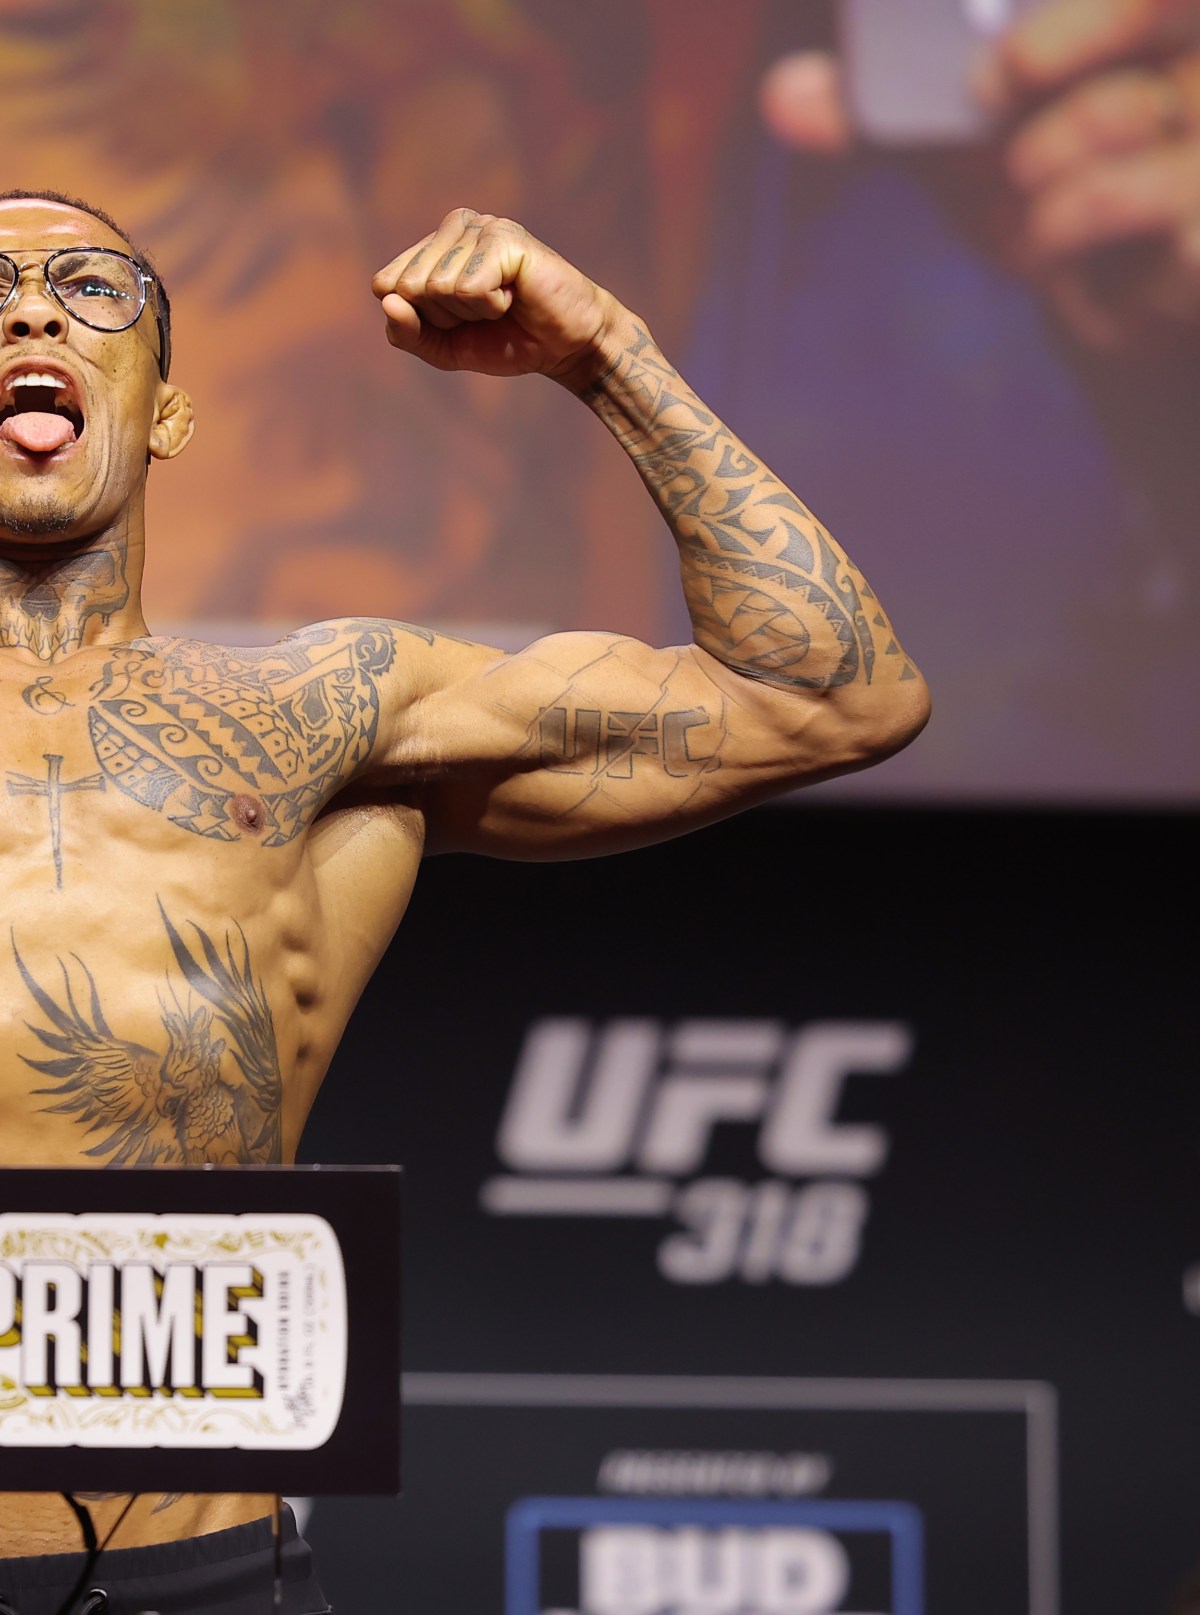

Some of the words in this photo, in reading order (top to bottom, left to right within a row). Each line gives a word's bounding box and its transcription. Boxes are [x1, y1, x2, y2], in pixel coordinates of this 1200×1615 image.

[538, 706, 722, 779] UFC
[498, 1018, 910, 1176] UFC
[658, 1177, 868, 1286] 318
[580, 1523, 850, 1614] BUD
